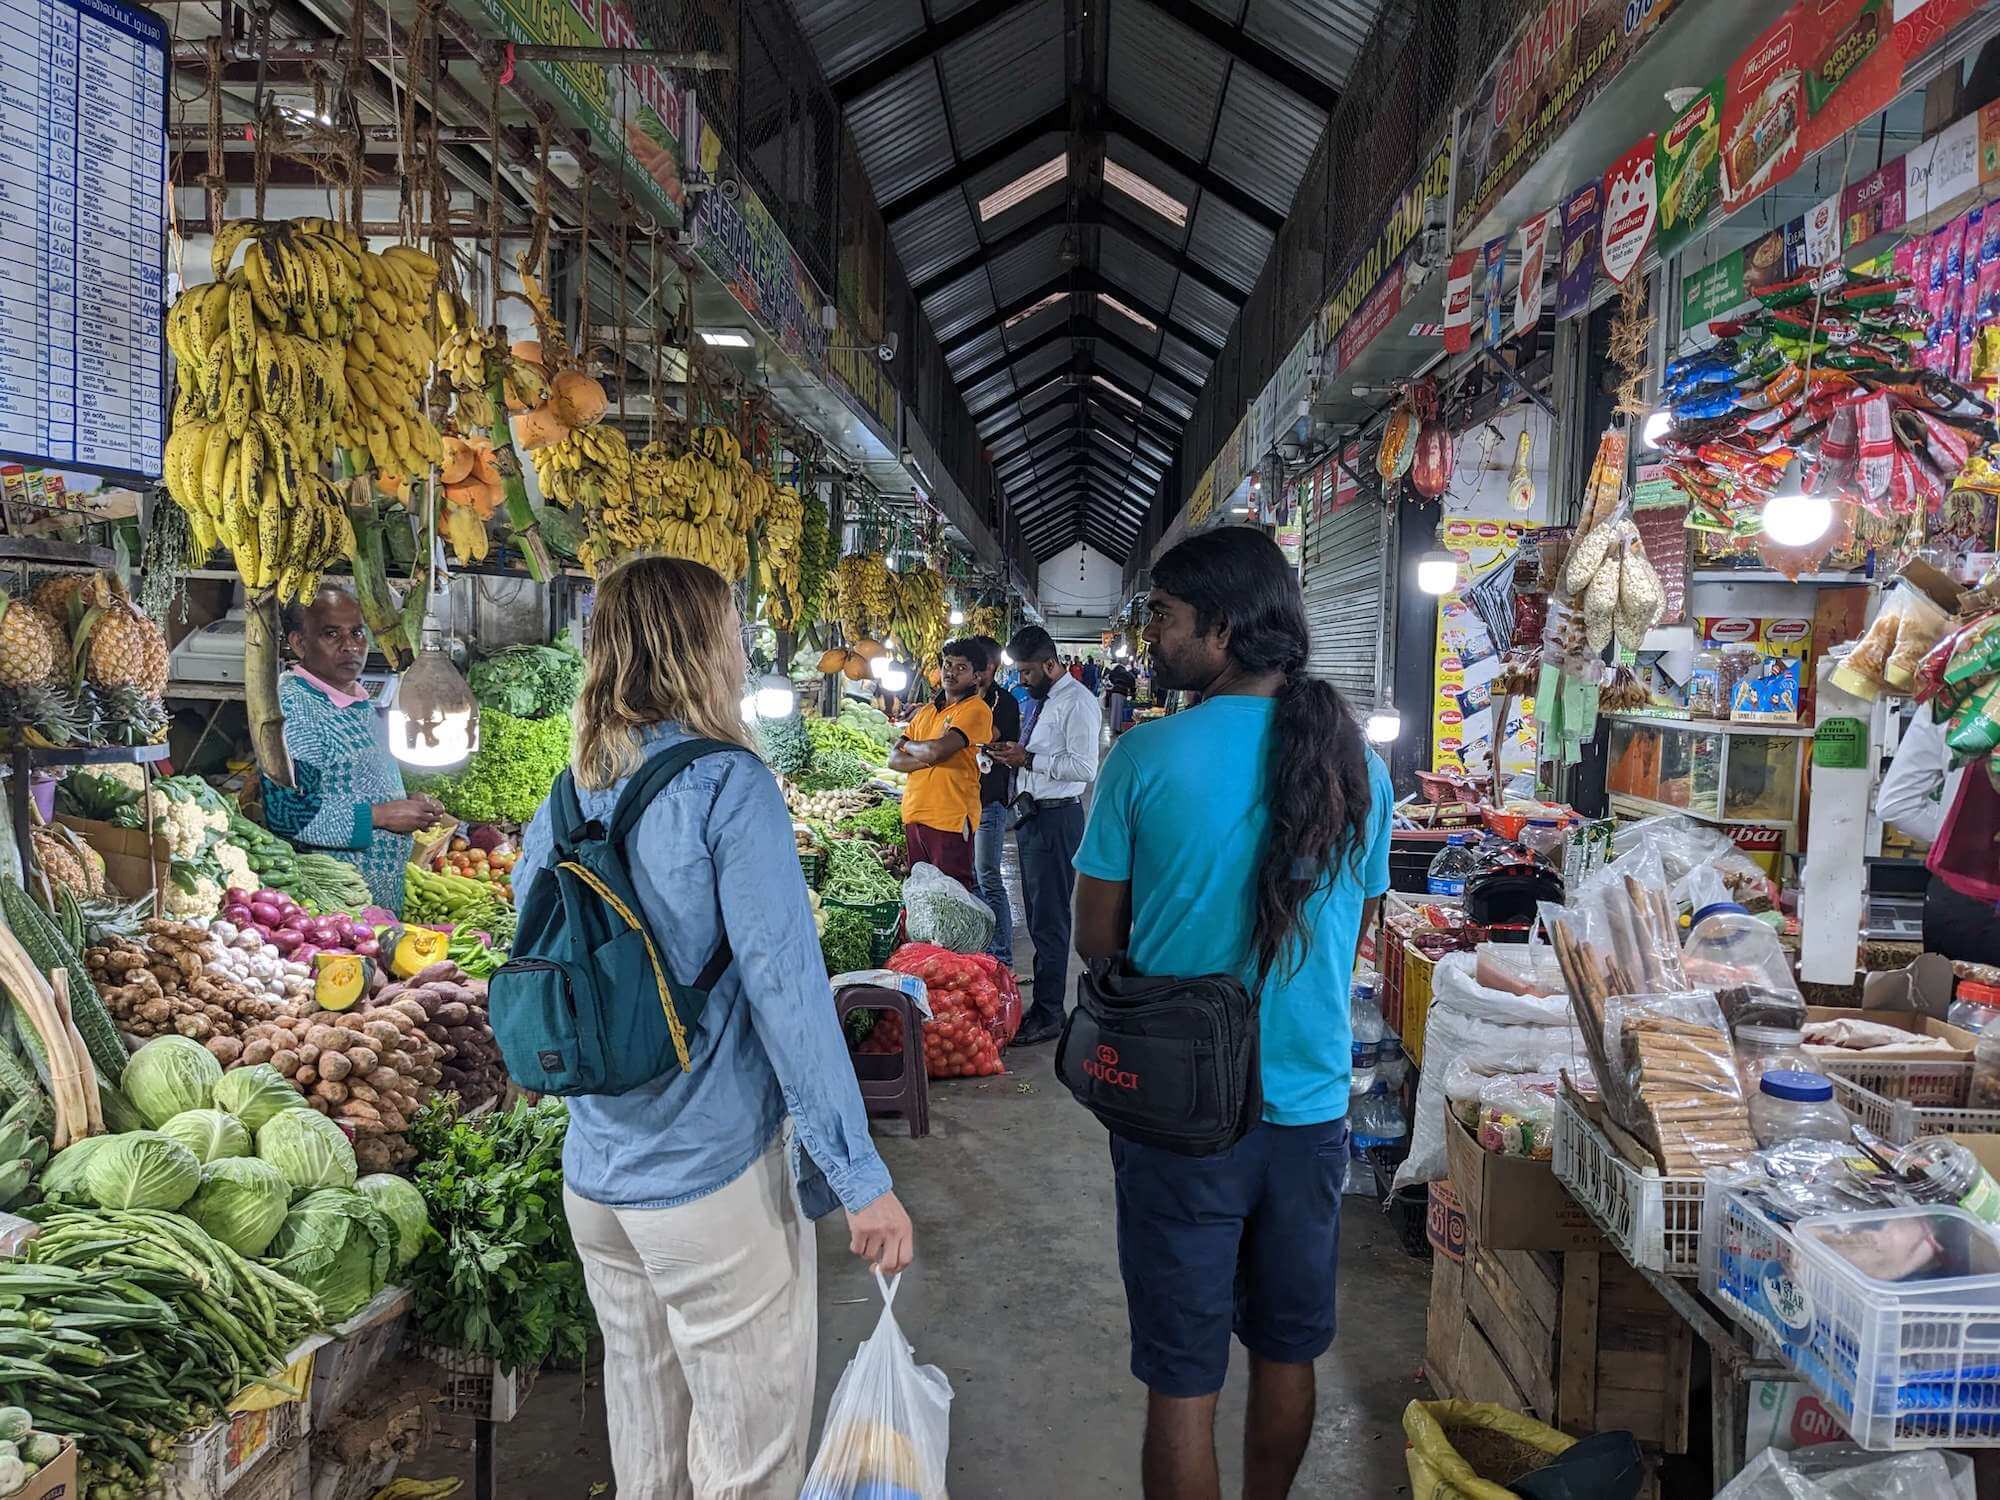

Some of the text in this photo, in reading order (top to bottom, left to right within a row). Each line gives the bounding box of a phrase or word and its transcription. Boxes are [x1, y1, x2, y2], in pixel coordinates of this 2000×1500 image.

[1744, 39, 1787, 79] Maliban
[1478, 161, 1504, 205] CENTER
[1503, 119, 1540, 178] MARKET,
[1540, 70, 1585, 131] NUWARA
[1585, 28, 1617, 80] ELIYA
[1610, 214, 1644, 237] Maliban
[1082, 1059, 1140, 1090] GUCCI
